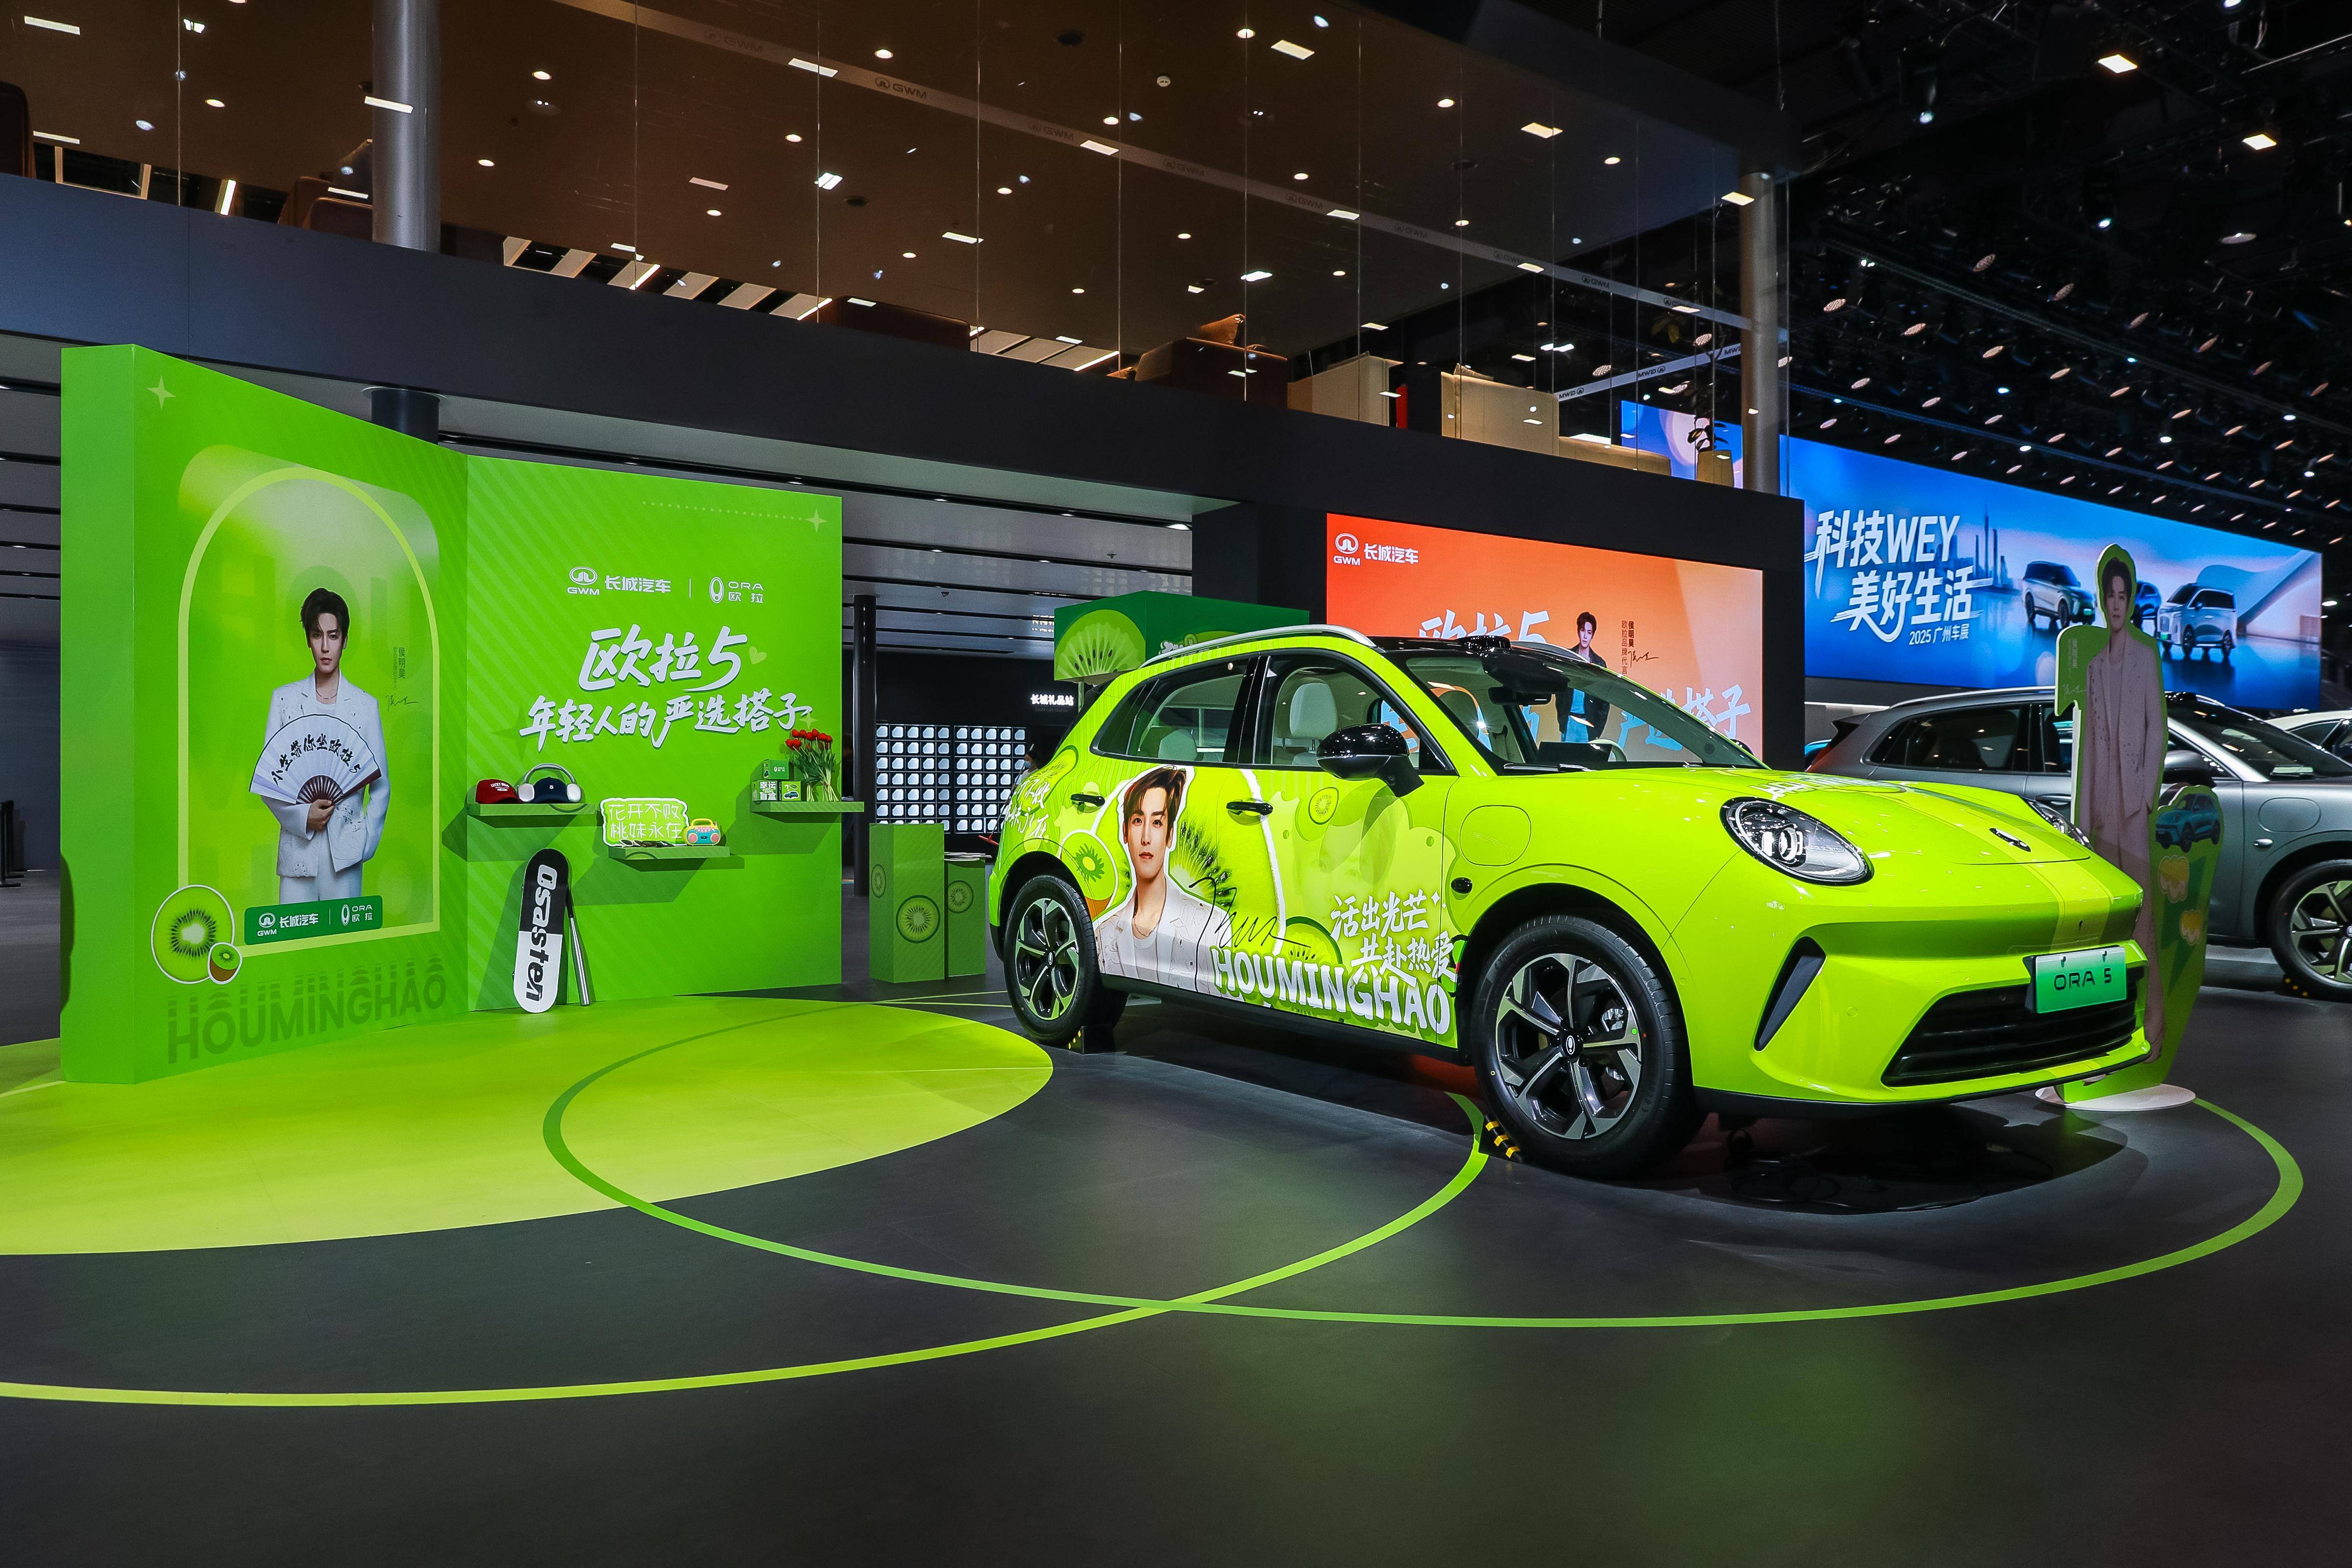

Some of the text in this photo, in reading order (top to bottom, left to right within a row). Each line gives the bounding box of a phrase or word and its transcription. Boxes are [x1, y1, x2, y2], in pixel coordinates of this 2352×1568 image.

[892, 84, 927, 98] GWM
[1592, 278, 1610, 288] GWM
[1333, 555, 1360, 566] GWM
[1364, 543, 1419, 564] 长城汽车
[1804, 510, 1960, 600] 科技WEY
[567, 587, 600, 596] GWM
[605, 575, 671, 593] 长城汽车
[728, 581, 764, 591] ORA
[728, 591, 764, 604] 欧拉
[1830, 565, 1993, 642] 美好生活
[1909, 623, 1970, 645] 2025 广州车展
[579, 624, 748, 692] 欧拉5
[519, 687, 813, 752] 年轻人的严选搭子
[608, 803, 681, 821] 花开不败
[610, 822, 682, 839] 桃妹永在
[280, 913, 318, 928] 长城汽车
[352, 912, 373, 922] 欧拉
[1330, 888, 1428, 942] 活出光芒
[1351, 930, 1457, 987] 共赴热爱
[2054, 967, 2111, 991] ORA 5
[1212, 947, 1450, 1035] HOUMINGHAO
[168, 963, 447, 1064] HOUMINGHAO
